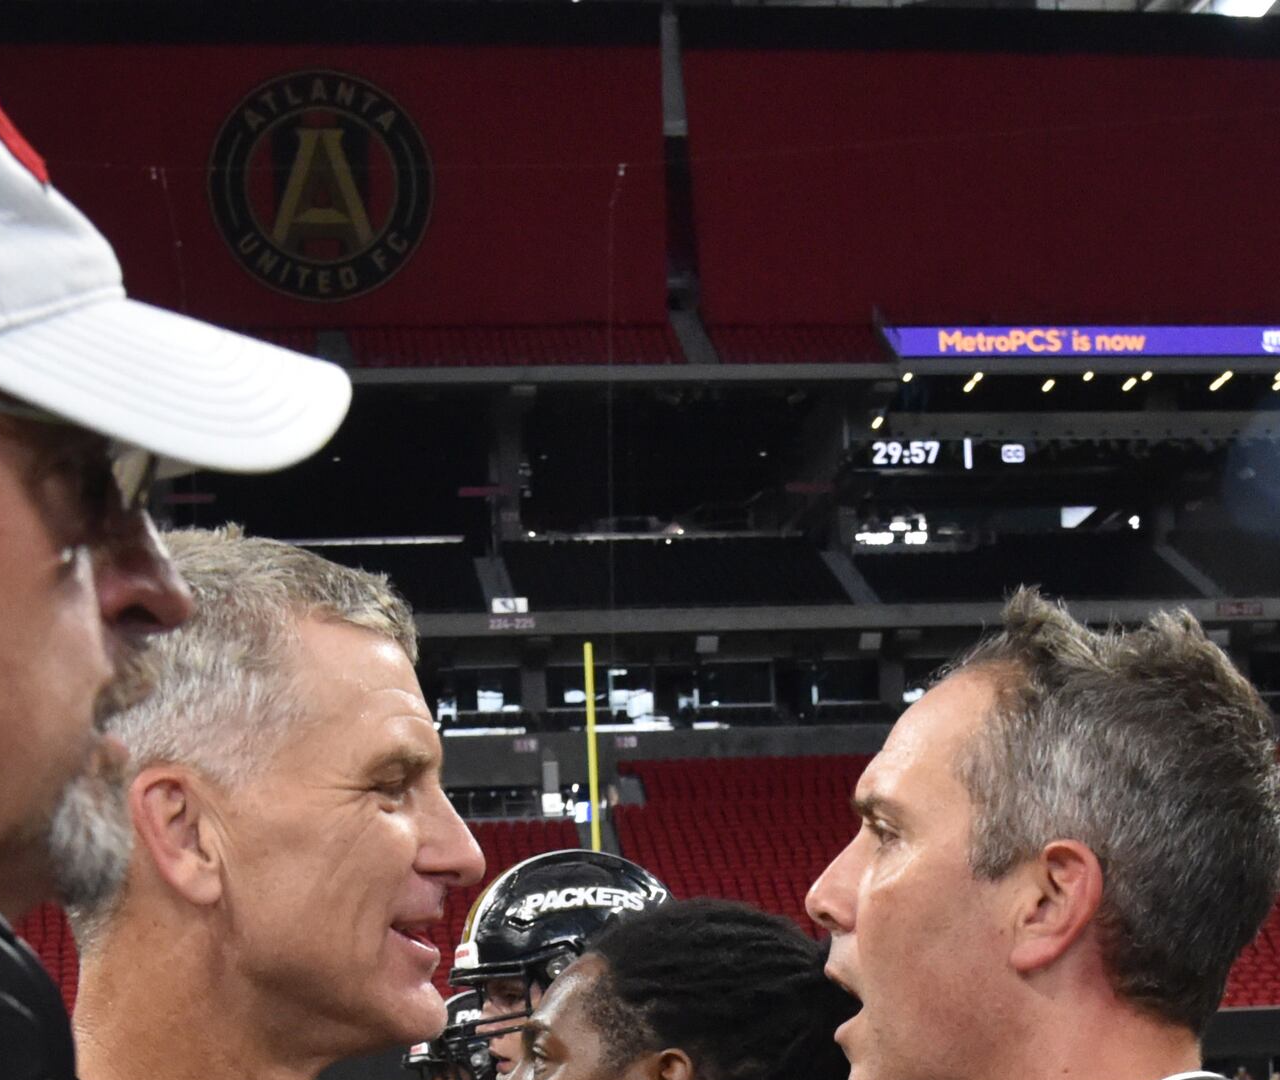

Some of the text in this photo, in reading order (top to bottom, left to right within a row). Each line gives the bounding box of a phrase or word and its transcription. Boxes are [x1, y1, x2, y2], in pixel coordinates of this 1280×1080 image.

[244, 78, 396, 131] ATLANTA
[238, 231, 411, 293] UNITED FC
[1072, 330, 1091, 352] is
[1095, 335, 1146, 352] now
[872, 441, 940, 465] 29:57
[524, 886, 645, 913] PACKERS
